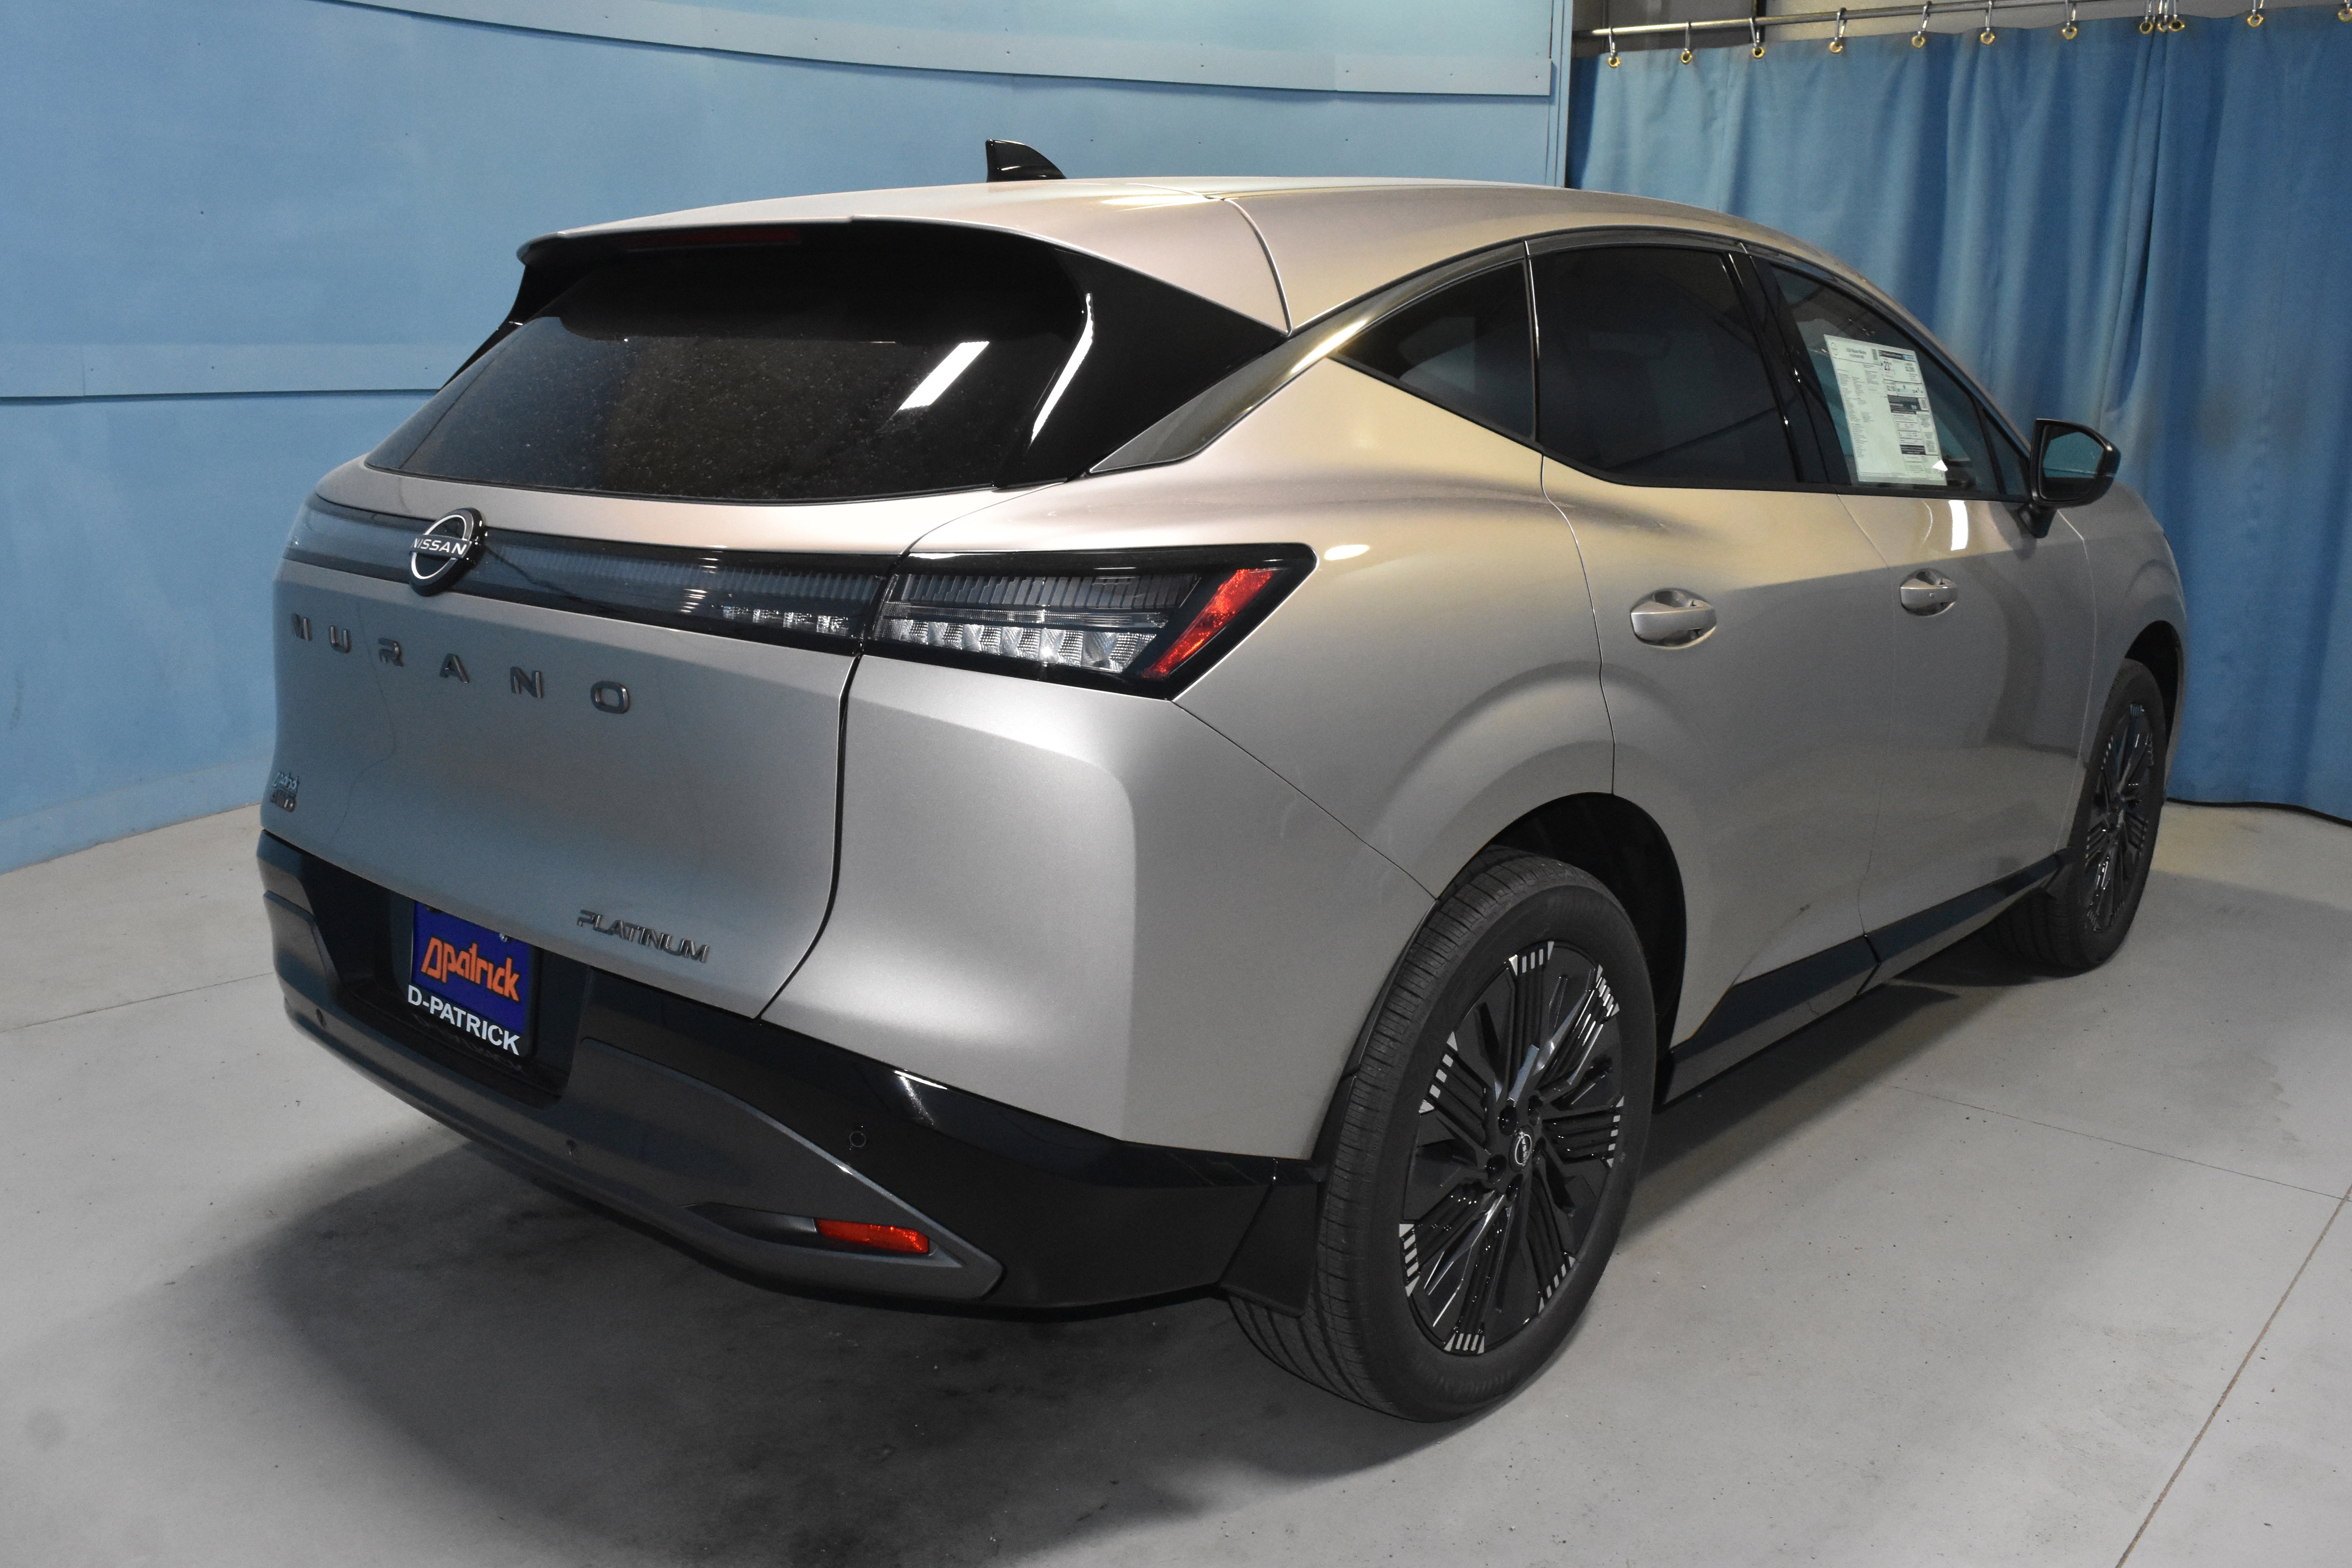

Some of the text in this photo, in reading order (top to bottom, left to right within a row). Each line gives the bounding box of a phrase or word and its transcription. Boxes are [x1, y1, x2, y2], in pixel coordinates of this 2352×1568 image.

[411, 538, 467, 555] NISSAN
[292, 613, 630, 714] MURANO
[577, 909, 710, 963] PLATINUM
[408, 984, 520, 1056] D-PATRICK
